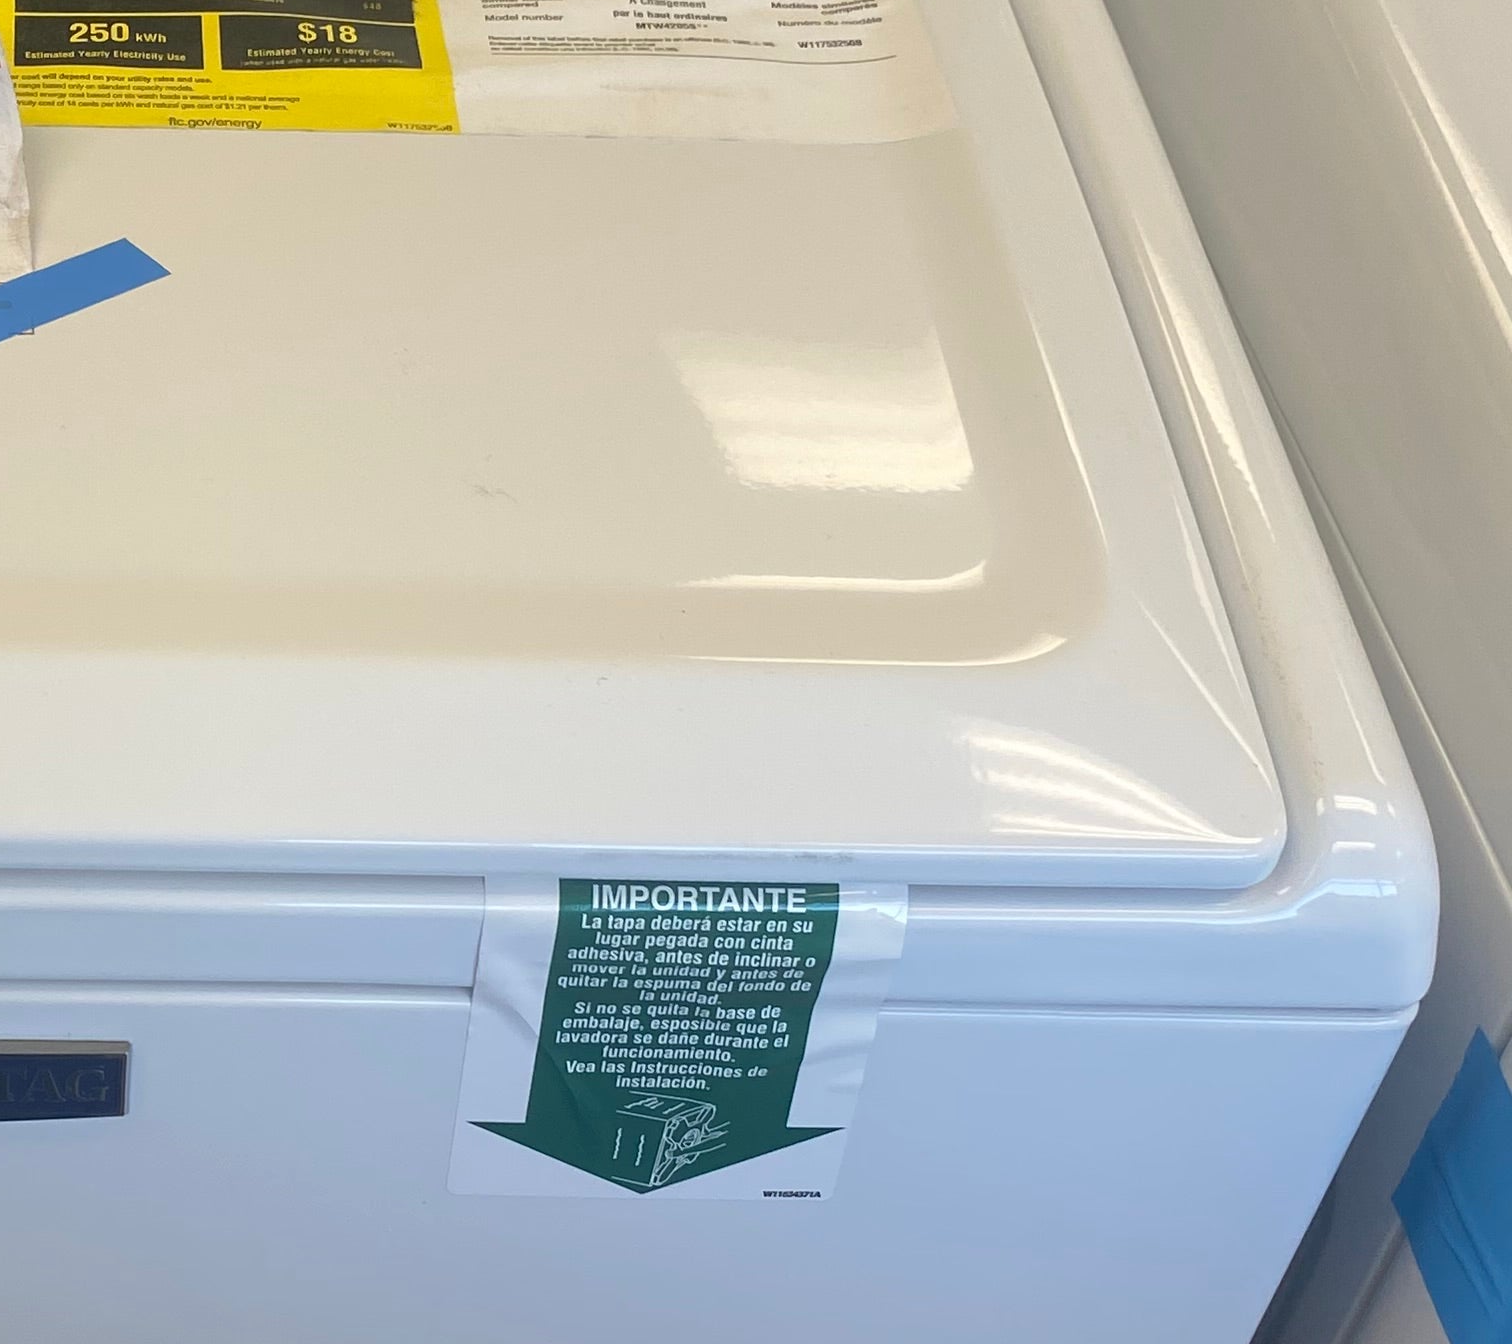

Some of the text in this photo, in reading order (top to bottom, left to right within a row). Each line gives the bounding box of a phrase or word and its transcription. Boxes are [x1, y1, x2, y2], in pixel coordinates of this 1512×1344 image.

[69, 23, 167, 43] 250 kWh
[298, 22, 358, 44] $18
[25, 50, 186, 61] Estimated Yearly Electricity Use
[168, 117, 262, 128] ftc.gov/energy
[592, 884, 807, 913] IMPORTANTE
[581, 913, 814, 933] La tapa deberá estar en su
[595, 932, 793, 951] lugar pegada con cinta
[568, 947, 816, 968] adhesiva, antes de inclinar o
[602, 1046, 736, 1062] funcionamiento.
[566, 1060, 768, 1078] Vea las Instrucciones de
[616, 1075, 711, 1090] instalación.
